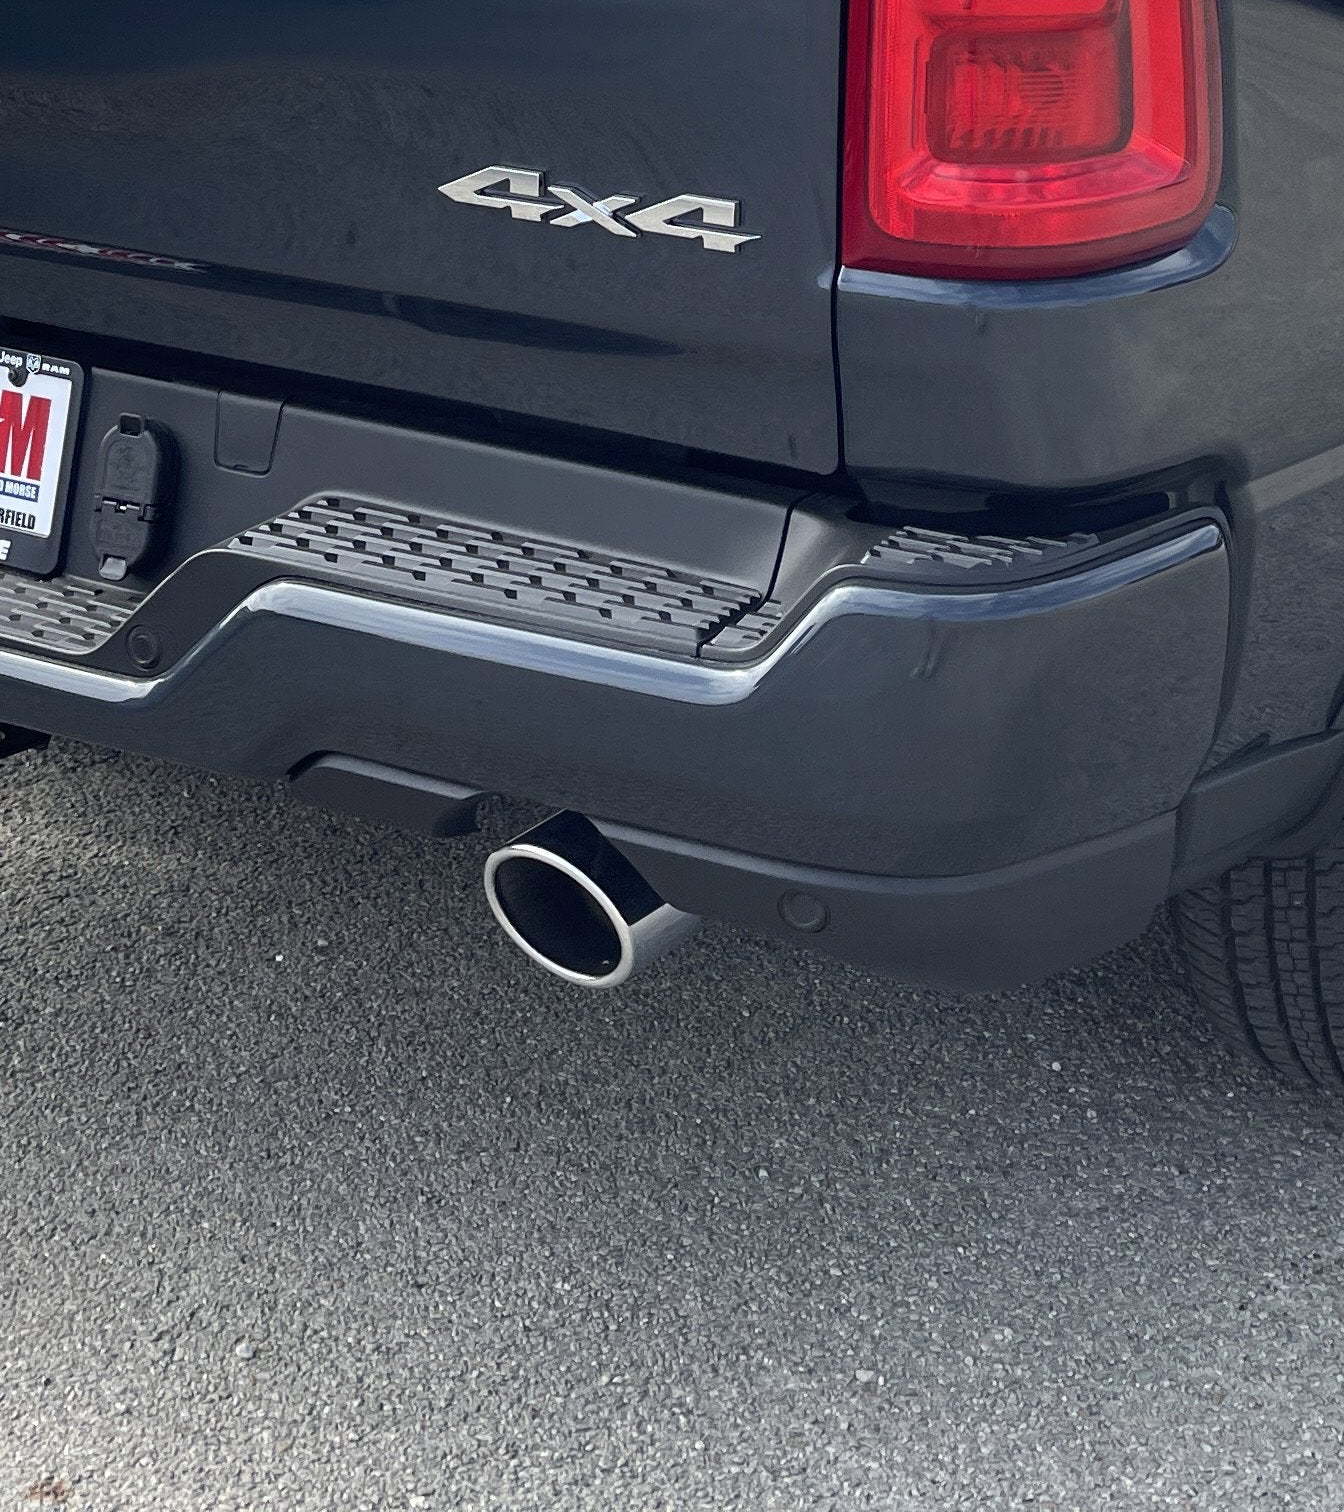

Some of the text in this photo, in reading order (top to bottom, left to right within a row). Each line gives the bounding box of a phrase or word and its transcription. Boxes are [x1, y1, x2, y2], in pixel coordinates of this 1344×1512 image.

[438, 165, 762, 253] 4x4
[41, 362, 70, 375] RAM
[5, 480, 37, 500] MORSE
